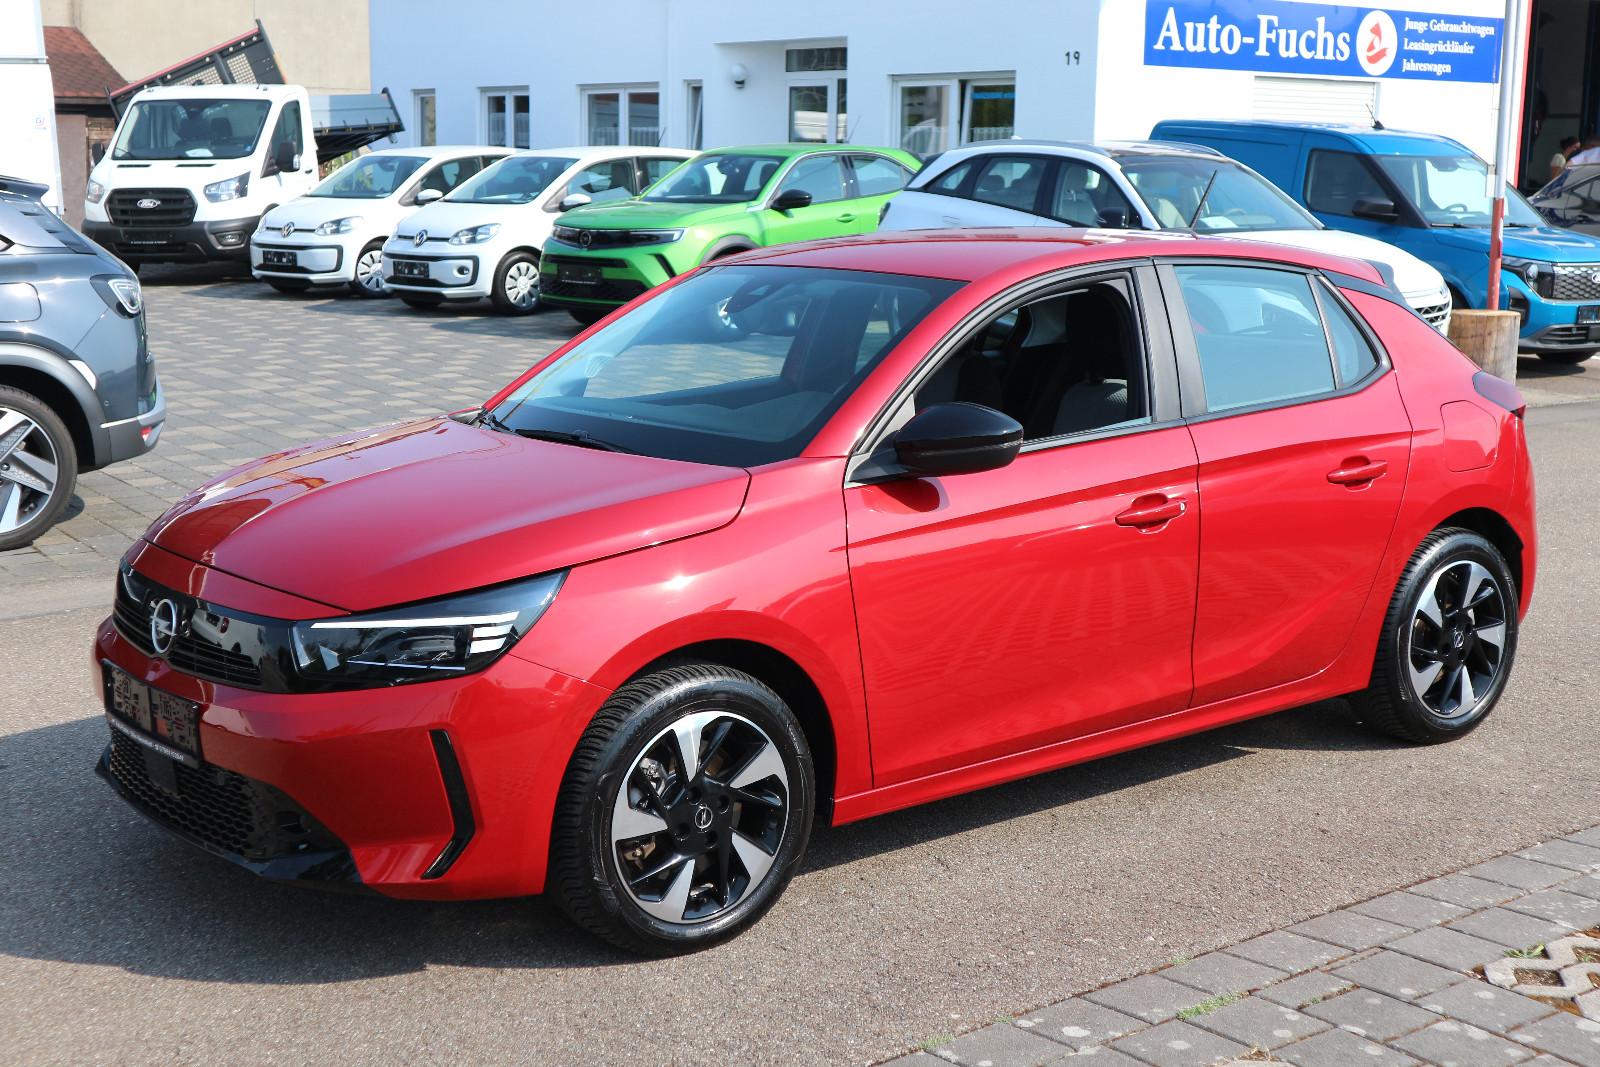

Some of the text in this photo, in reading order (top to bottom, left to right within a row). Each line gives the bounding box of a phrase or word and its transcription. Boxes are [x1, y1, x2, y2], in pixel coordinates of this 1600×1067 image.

[1153, 6, 1351, 62] Auto-Fuchs
[1405, 17, 1495, 38] Junge Gebrauchtwagen
[1065, 51, 1080, 66] 19
[1402, 59, 1452, 76] Jahreswagen
